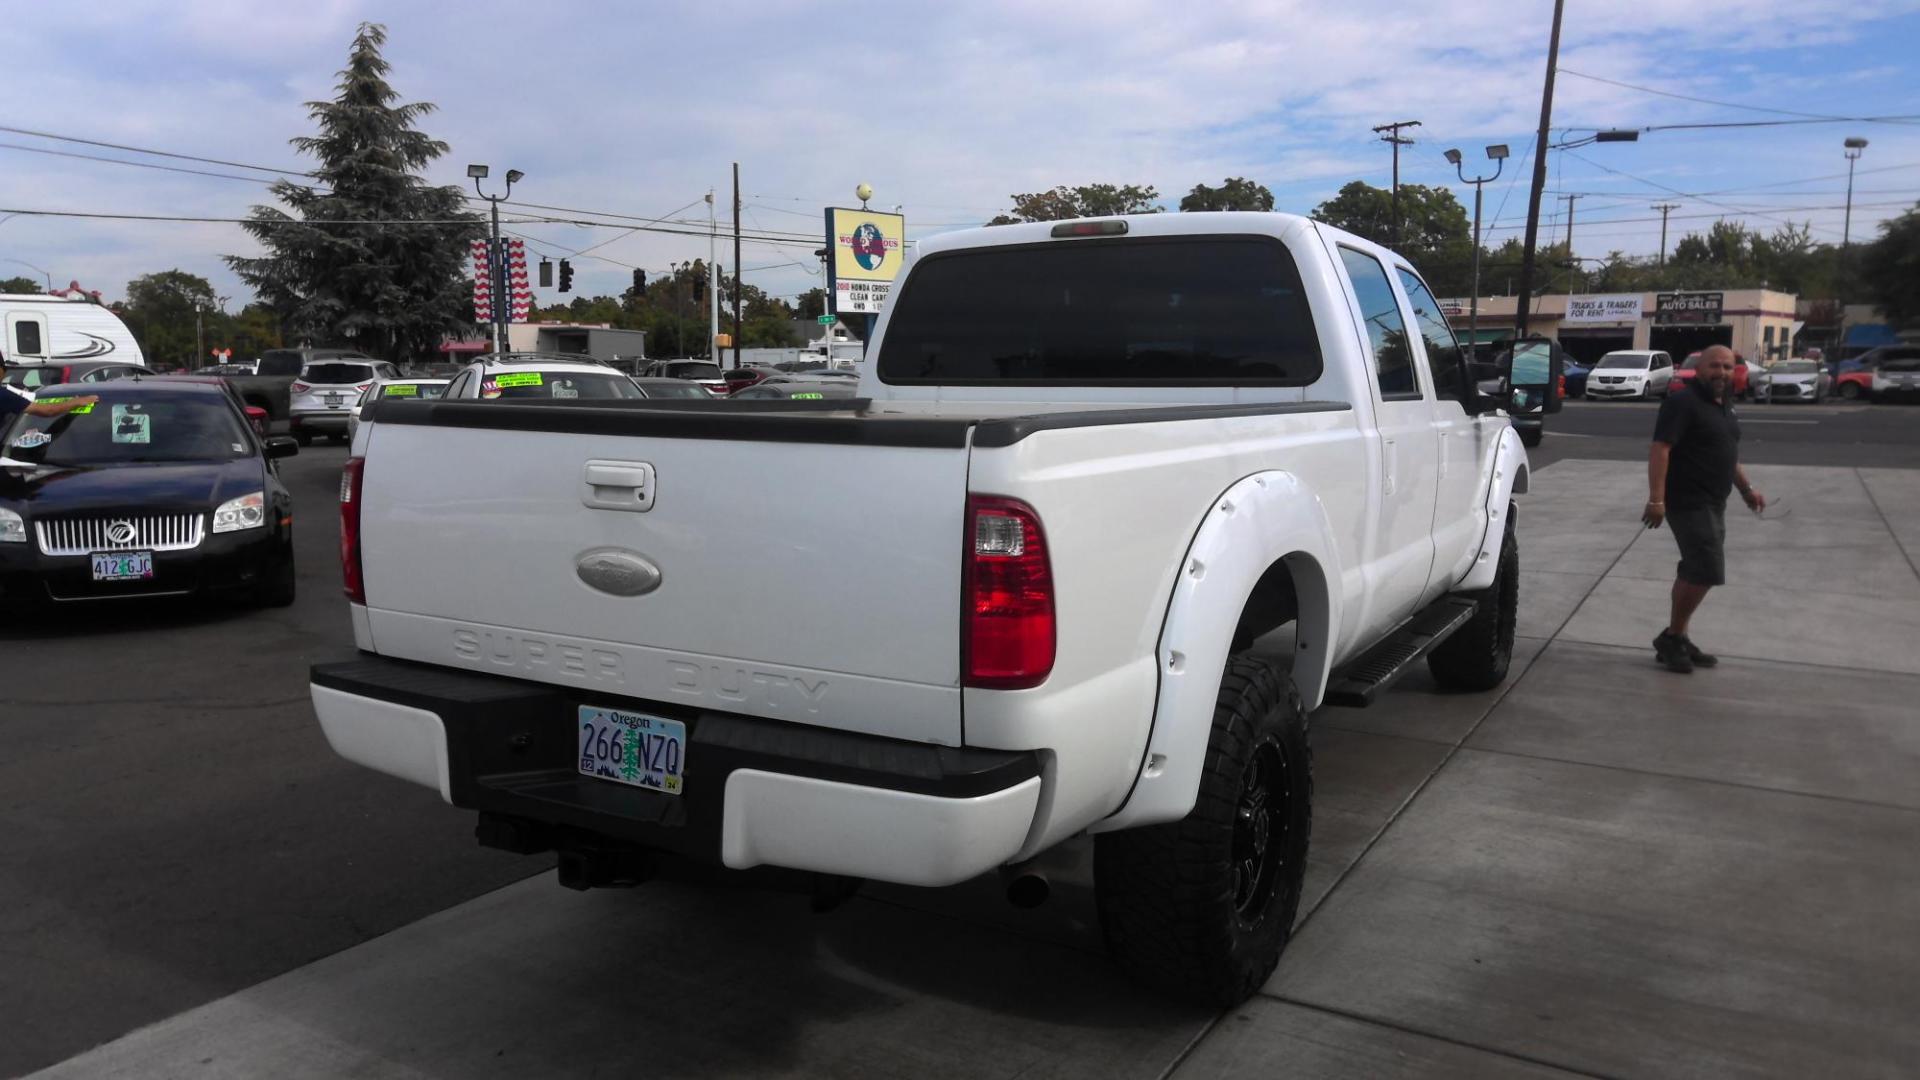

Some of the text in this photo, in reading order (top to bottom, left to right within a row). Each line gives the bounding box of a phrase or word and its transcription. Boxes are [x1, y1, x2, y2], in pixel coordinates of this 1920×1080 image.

[851, 283, 870, 291] HONDA
[871, 284, 891, 292] CROSS
[850, 292, 868, 300] CLEAN
[1570, 301, 1595, 310] TRUCKS
[1661, 300, 1719, 310] AUTO SALES
[1570, 309, 1585, 317] FOR
[1587, 309, 1605, 317] RENT
[94, 559, 151, 575] 412 GJC
[452, 628, 830, 713] SUPER DUTY
[610, 711, 651, 729] Oregon
[583, 723, 679, 775] 266 NZQ
